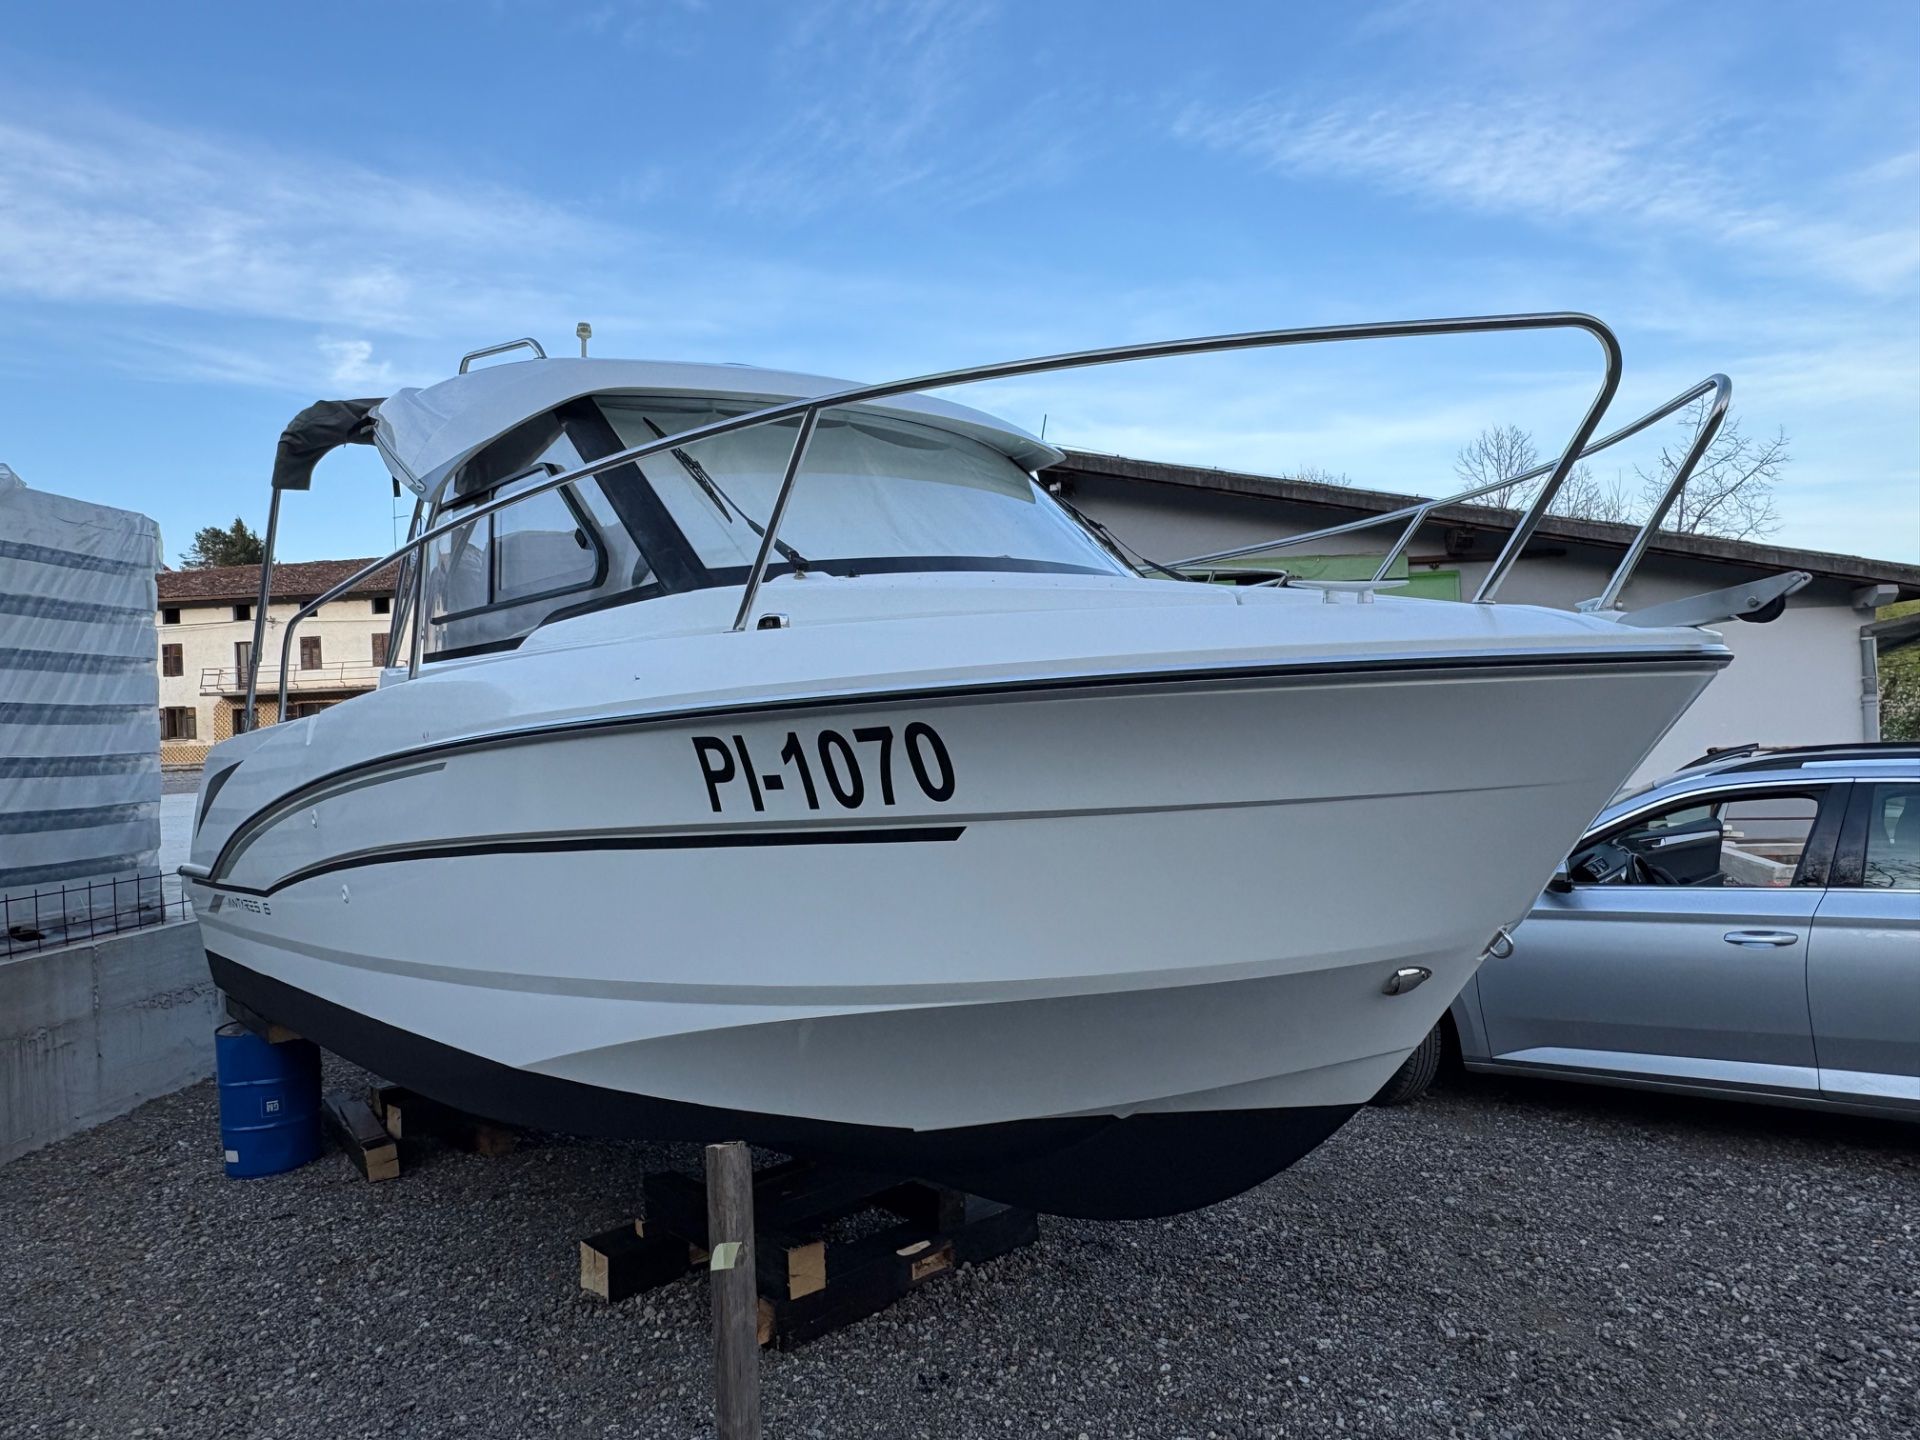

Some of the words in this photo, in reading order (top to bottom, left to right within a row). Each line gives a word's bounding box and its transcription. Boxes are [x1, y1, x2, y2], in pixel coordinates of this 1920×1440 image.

[691, 721, 956, 812] PI-1070
[262, 903, 272, 916] 6
[266, 1101, 280, 1113] GM
